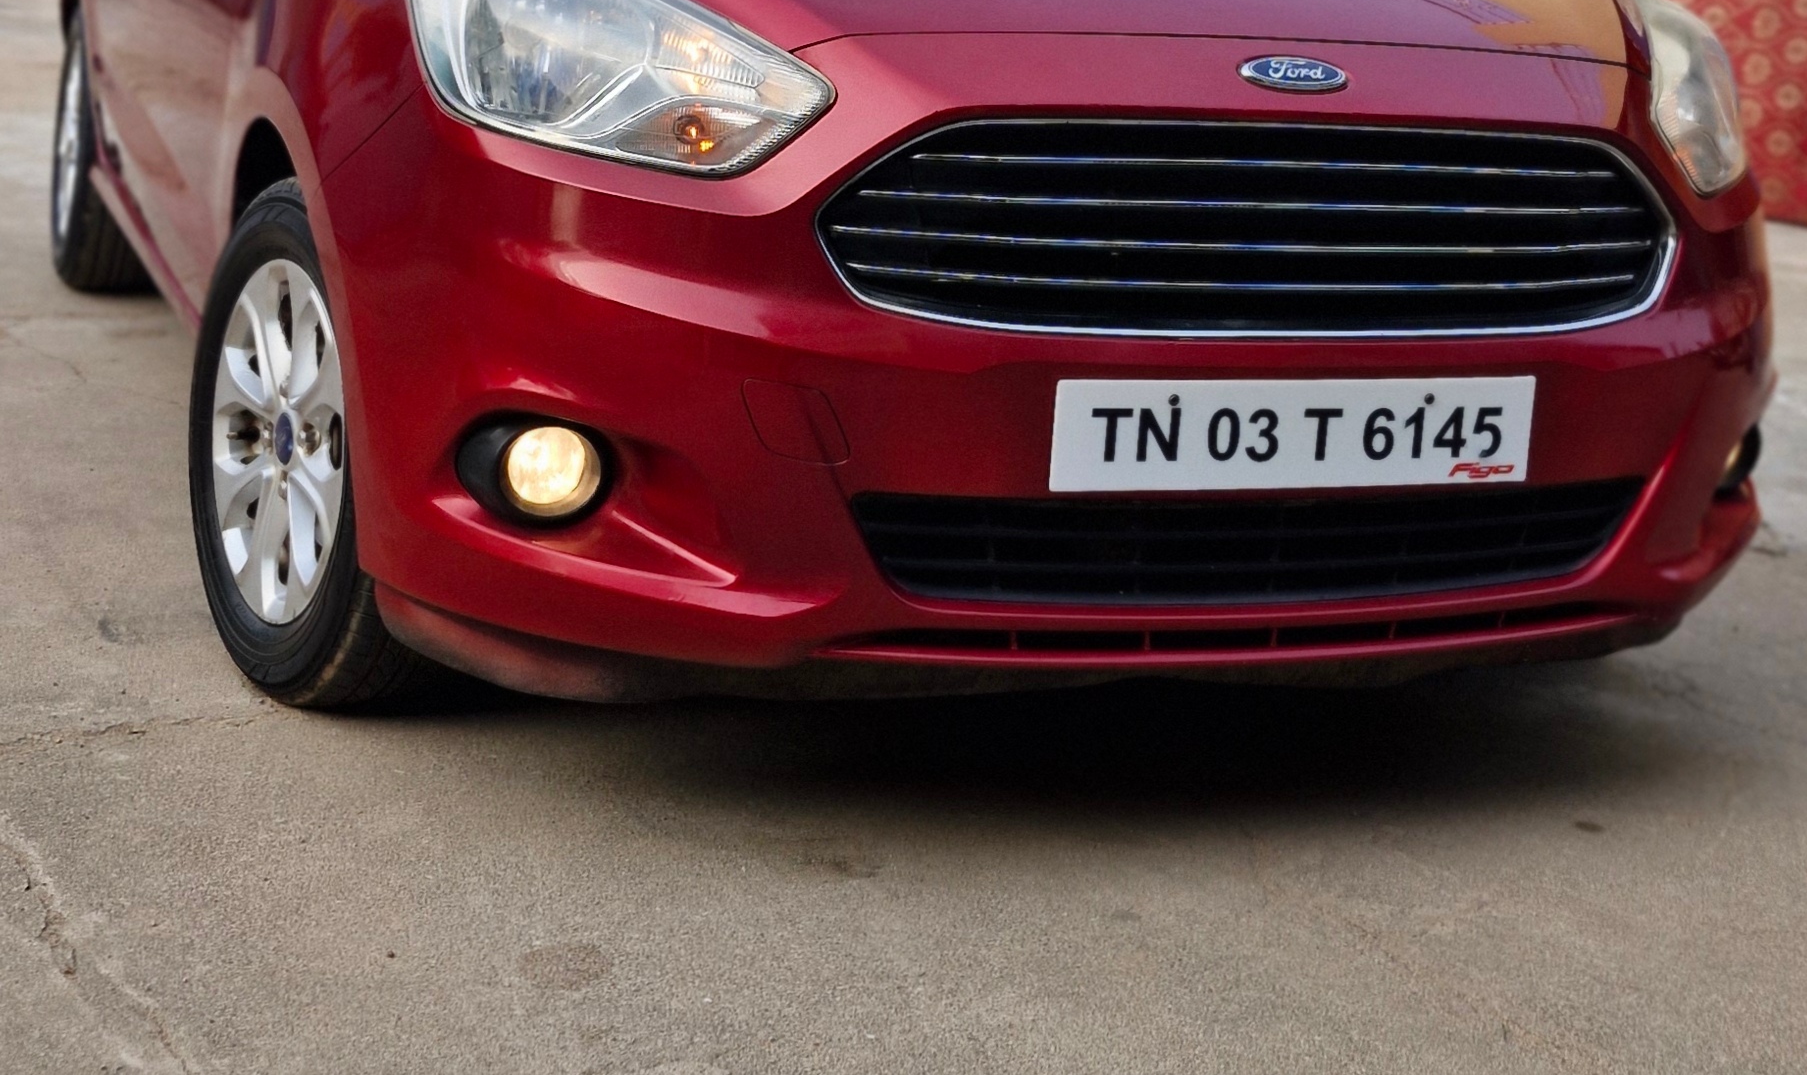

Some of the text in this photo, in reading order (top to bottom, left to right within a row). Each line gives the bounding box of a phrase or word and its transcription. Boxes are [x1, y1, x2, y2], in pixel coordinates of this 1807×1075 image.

[1268, 60, 1326, 79] Ford
[1091, 406, 1503, 462] TN 03 T 6145
[1448, 462, 1515, 479] Figo
